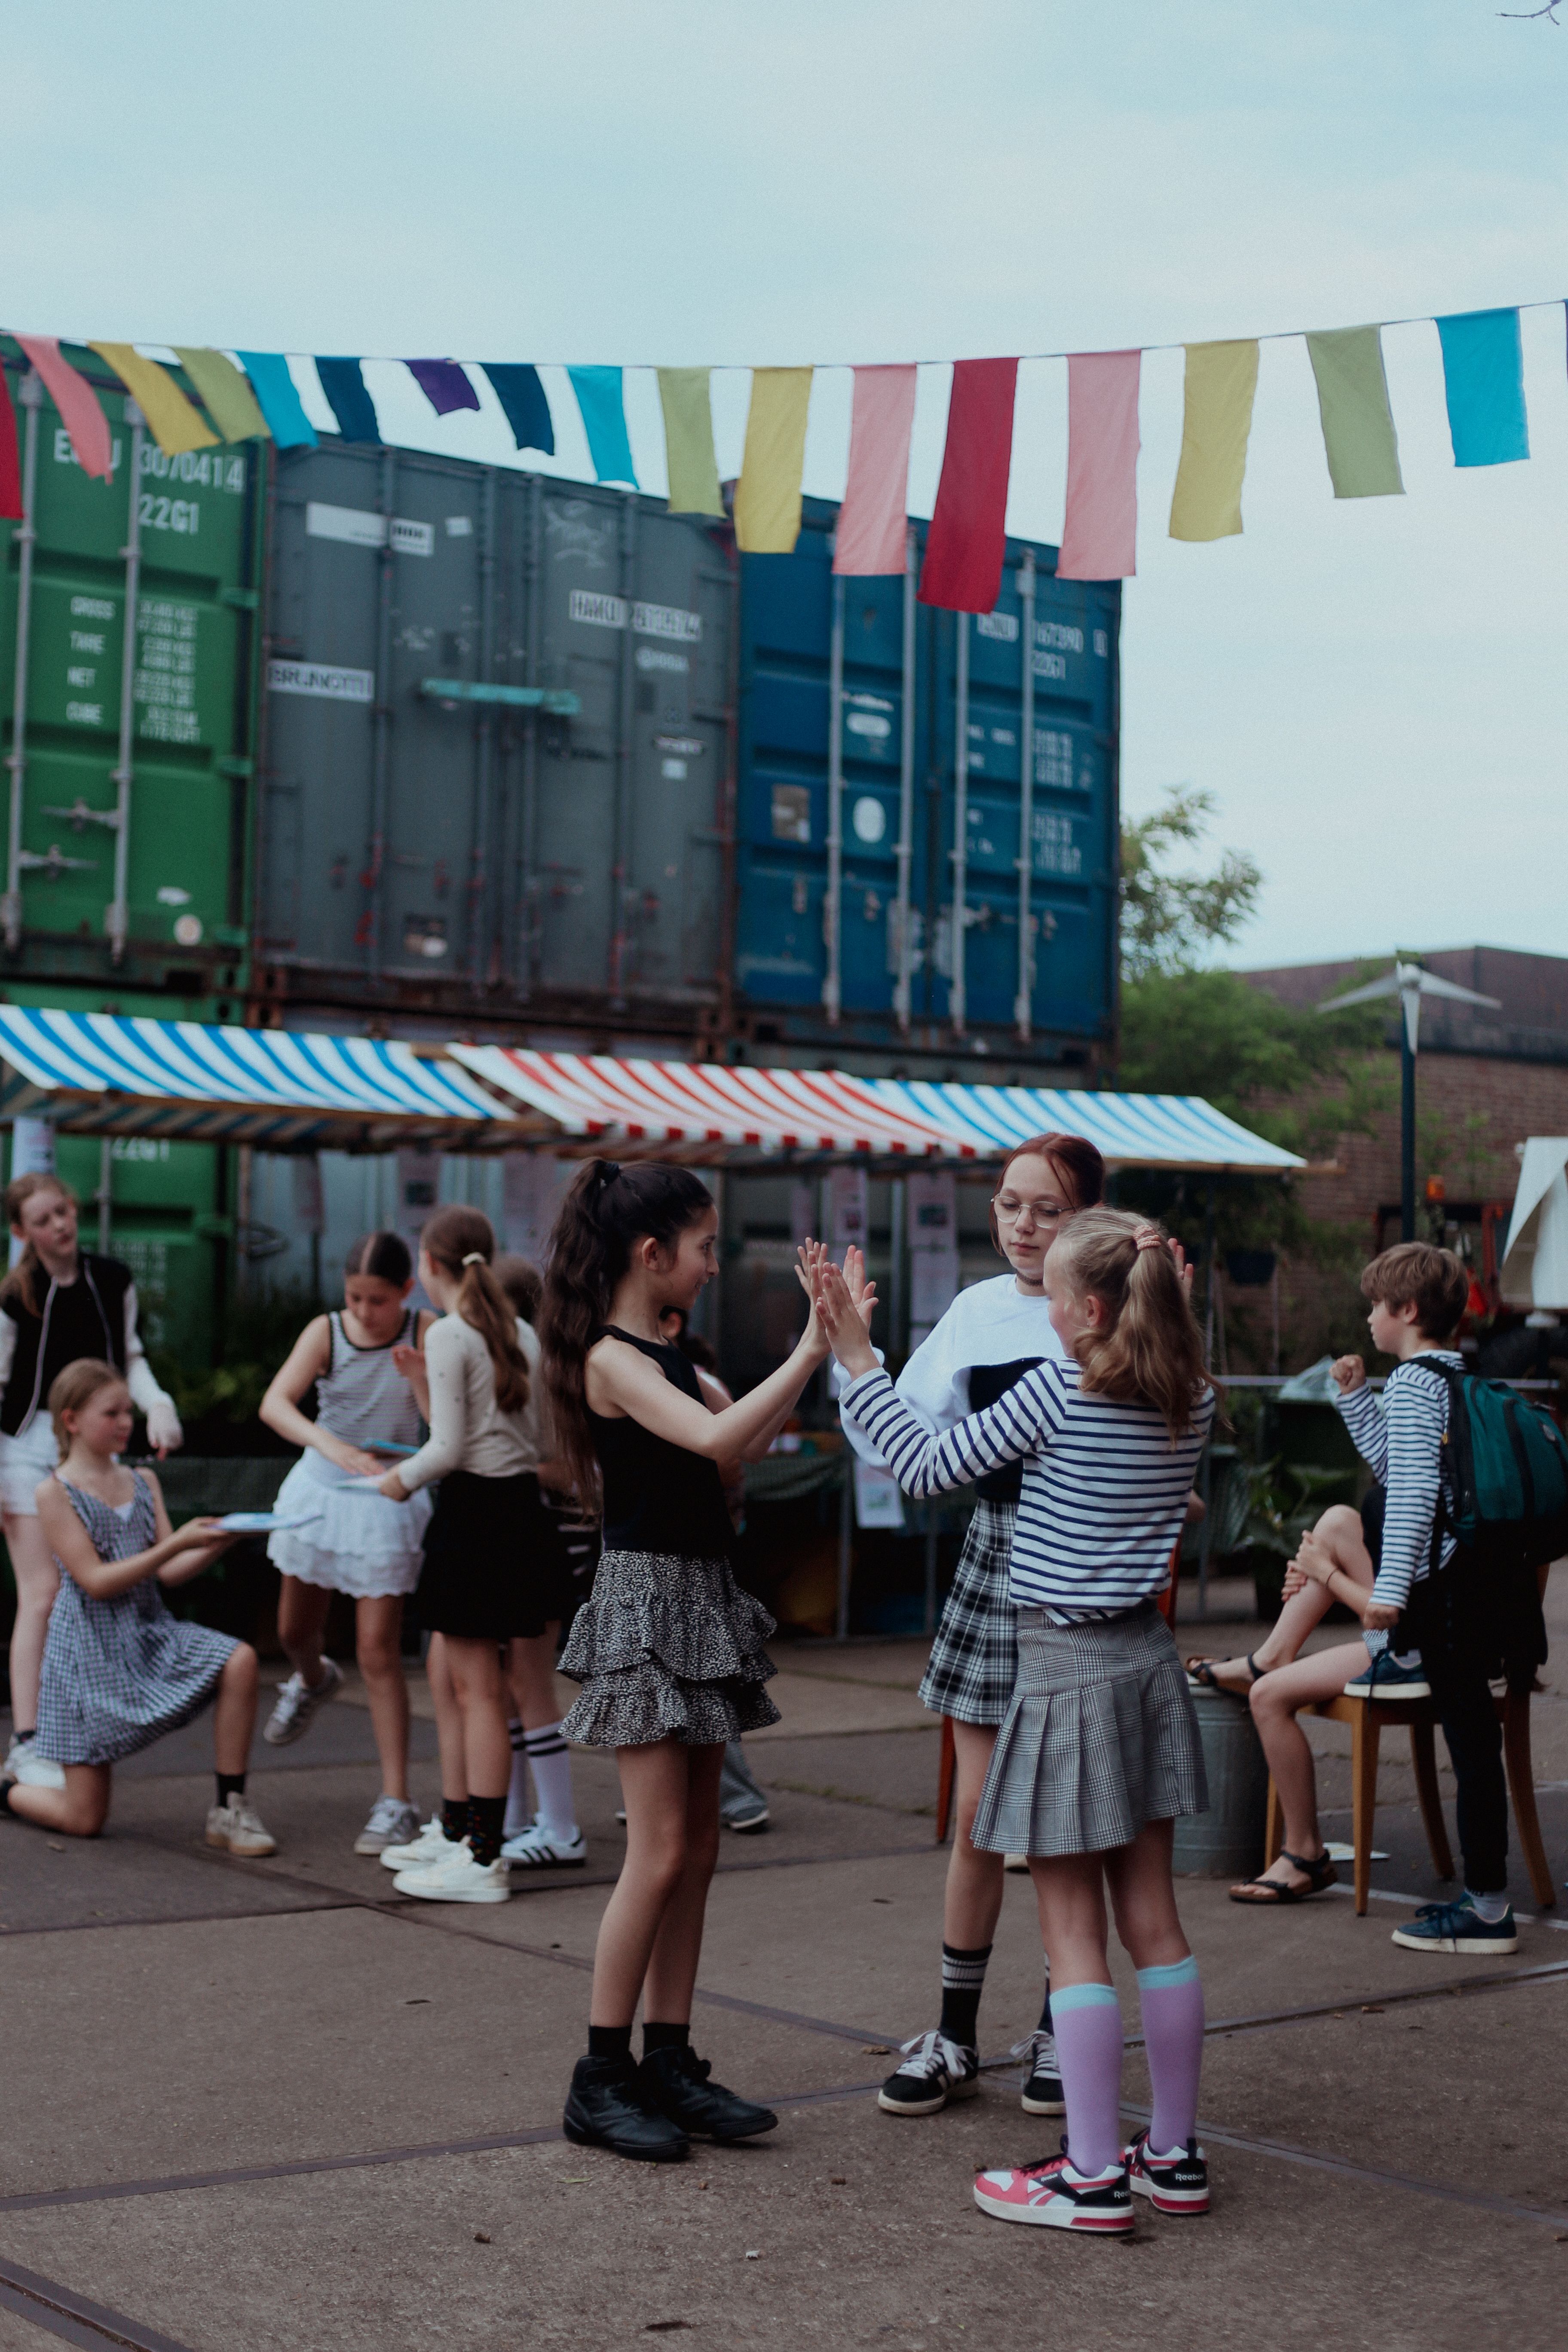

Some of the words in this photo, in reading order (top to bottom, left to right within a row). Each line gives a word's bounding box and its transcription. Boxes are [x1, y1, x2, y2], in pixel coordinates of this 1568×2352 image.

[139, 493, 199, 536] 22G1
[1041, 2173, 1058, 2182] Reebok
[1175, 2173, 1204, 2181] Reebo
